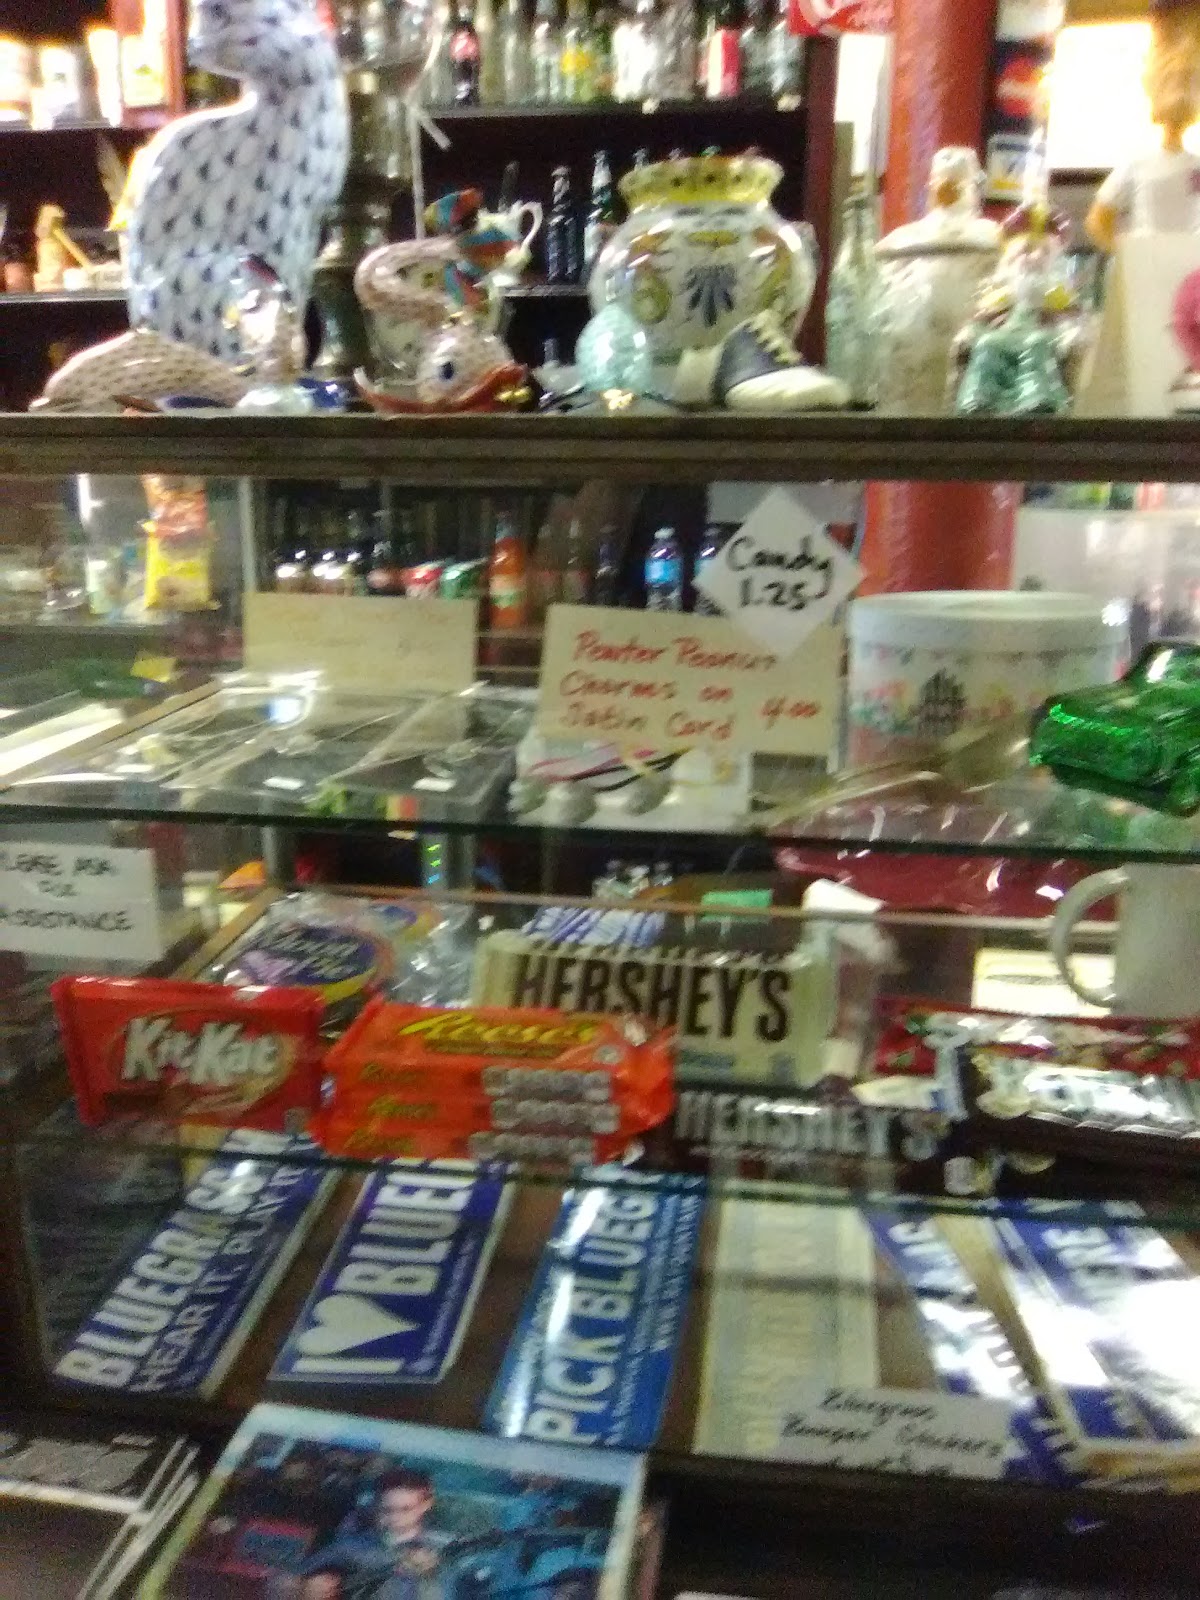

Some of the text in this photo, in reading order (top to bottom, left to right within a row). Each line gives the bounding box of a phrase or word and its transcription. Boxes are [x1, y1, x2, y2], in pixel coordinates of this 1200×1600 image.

[726, 535, 834, 600] Candy
[511, 956, 791, 1044] HERSHEY'S
[524, 1335, 627, 1447] PICK
